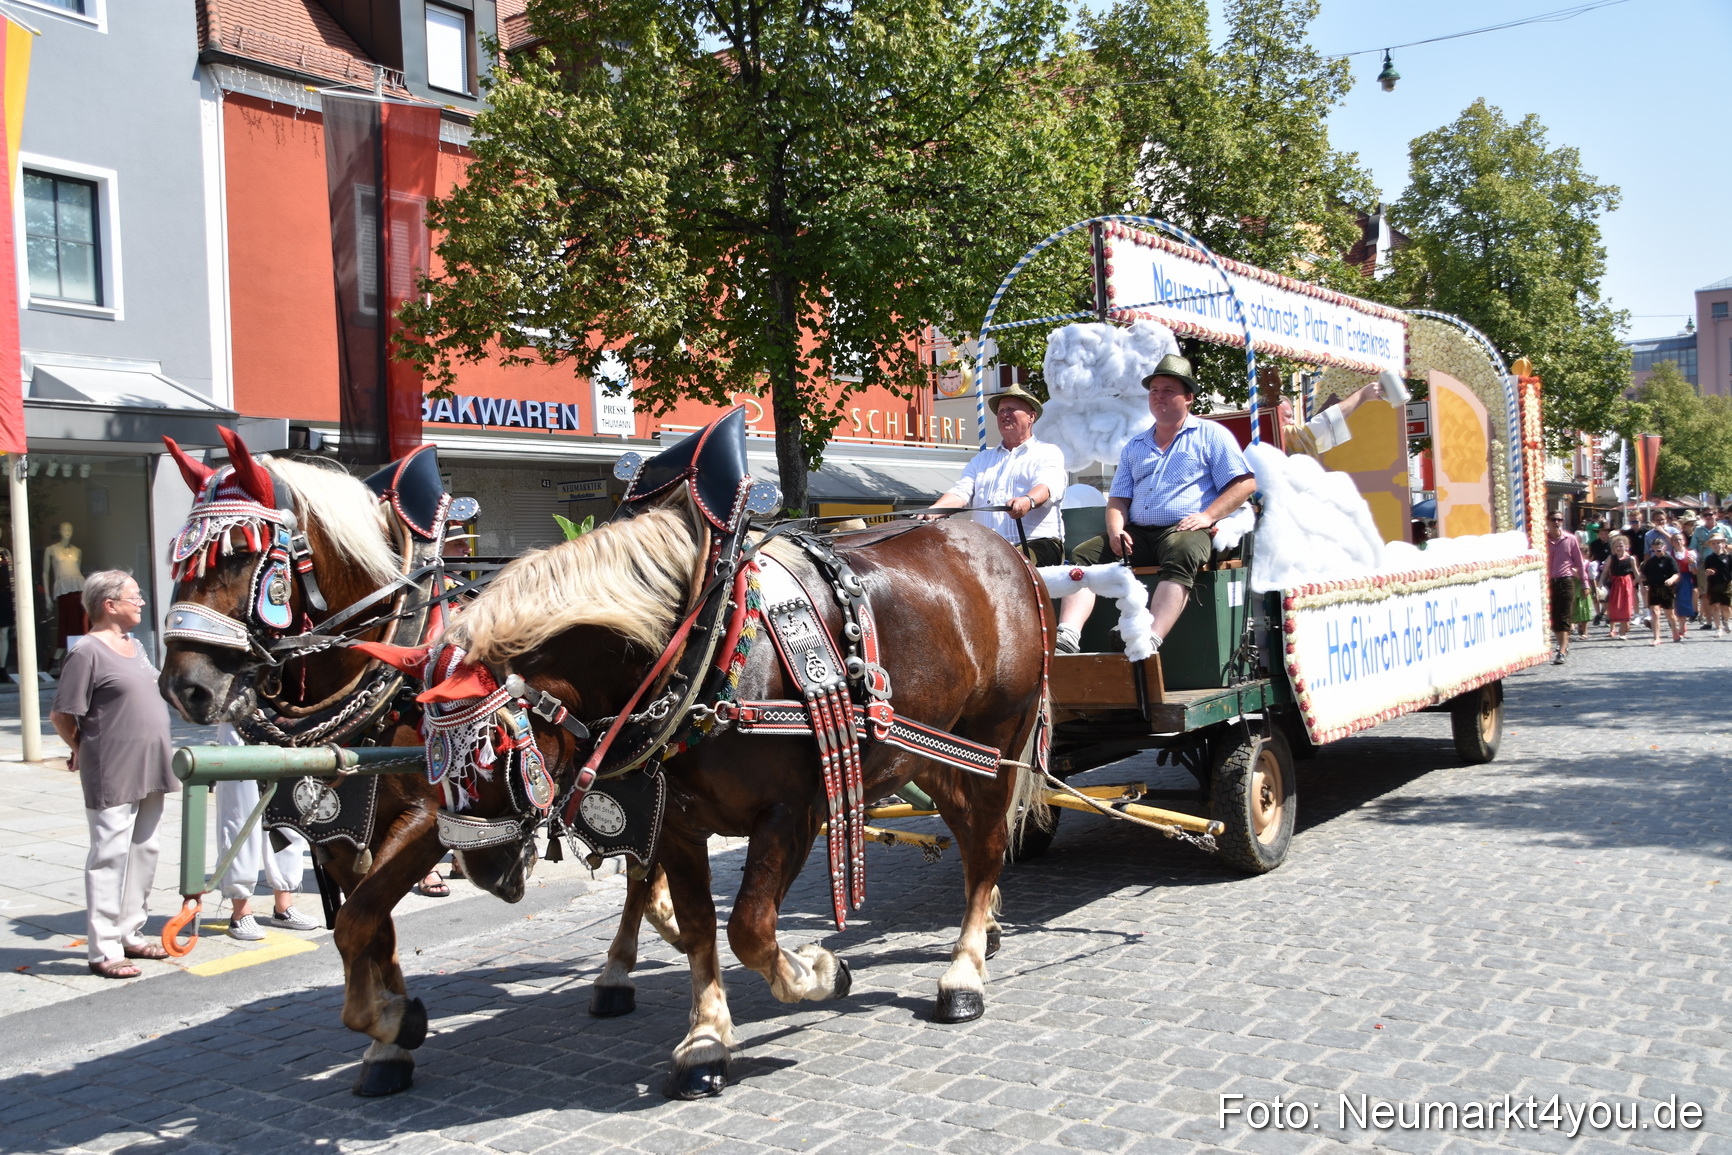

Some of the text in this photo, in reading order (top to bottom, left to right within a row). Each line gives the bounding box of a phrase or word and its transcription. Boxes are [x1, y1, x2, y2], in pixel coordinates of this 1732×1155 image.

[1152, 261, 1221, 319] Neumarkt
[1250, 295, 1299, 338] schönste
[1304, 305, 1329, 345] Platz
[1332, 315, 1344, 348] im
[603, 404, 628, 415] PRESSE
[602, 418, 631, 429] THUMANN
[850, 407, 966, 440] SCHLIERF
[562, 482, 602, 493] NEUMARKTER
[1403, 606, 1423, 667] die
[1462, 611, 1485, 649] zum
[1490, 584, 1532, 639] Paradeis
